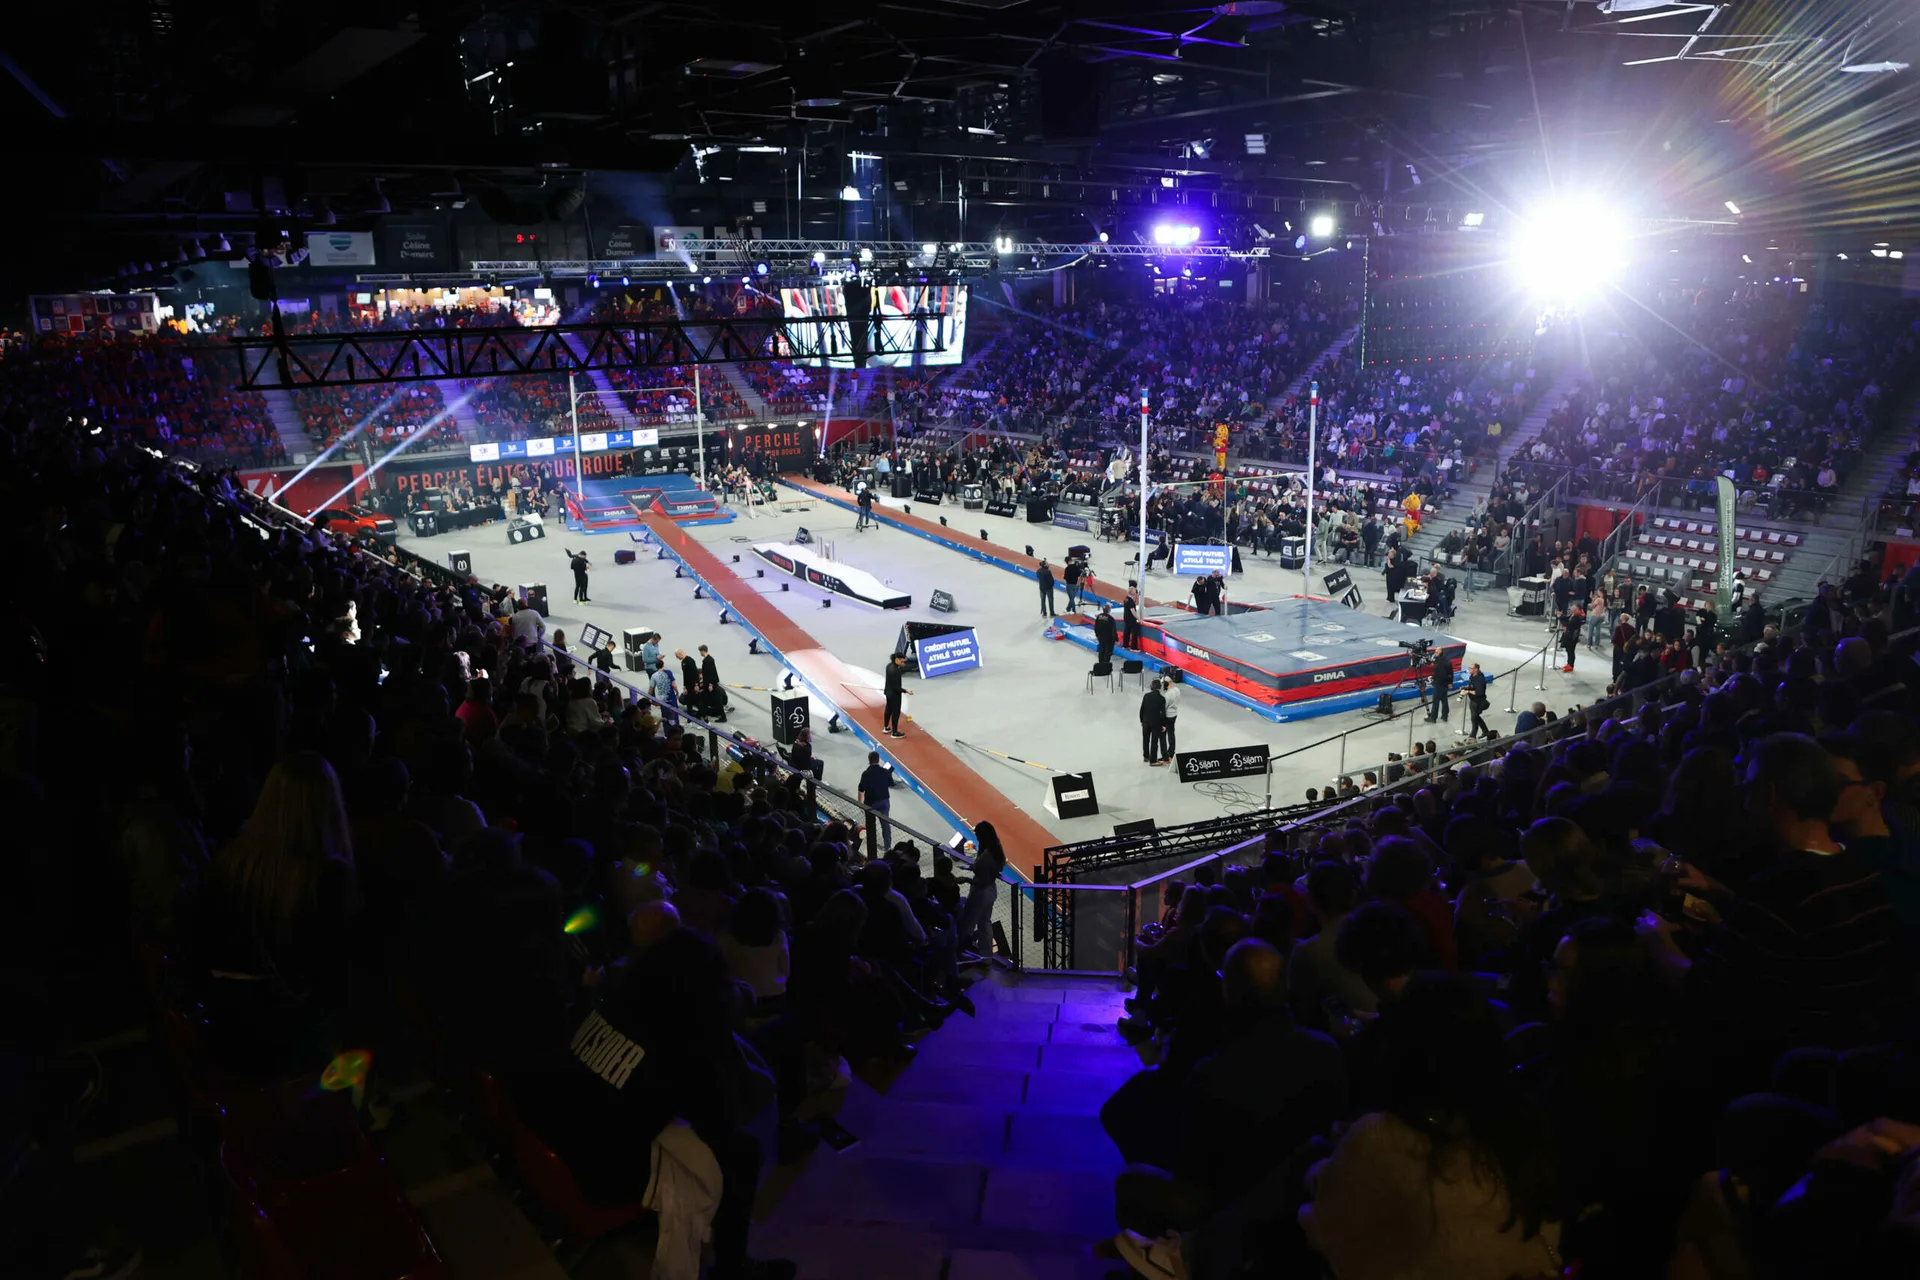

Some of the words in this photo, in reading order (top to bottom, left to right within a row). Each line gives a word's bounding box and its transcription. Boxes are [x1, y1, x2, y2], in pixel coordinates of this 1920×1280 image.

[745, 432, 801, 449] PERCHE
[924, 642, 947, 654] CRÉDIT
[947, 637, 972, 648] MUTUEL
[1186, 644, 1210, 661] DIMA
[928, 650, 951, 662] ATHLÉ
[951, 647, 971, 657] TOUR
[1313, 669, 1346, 683] DIMA
